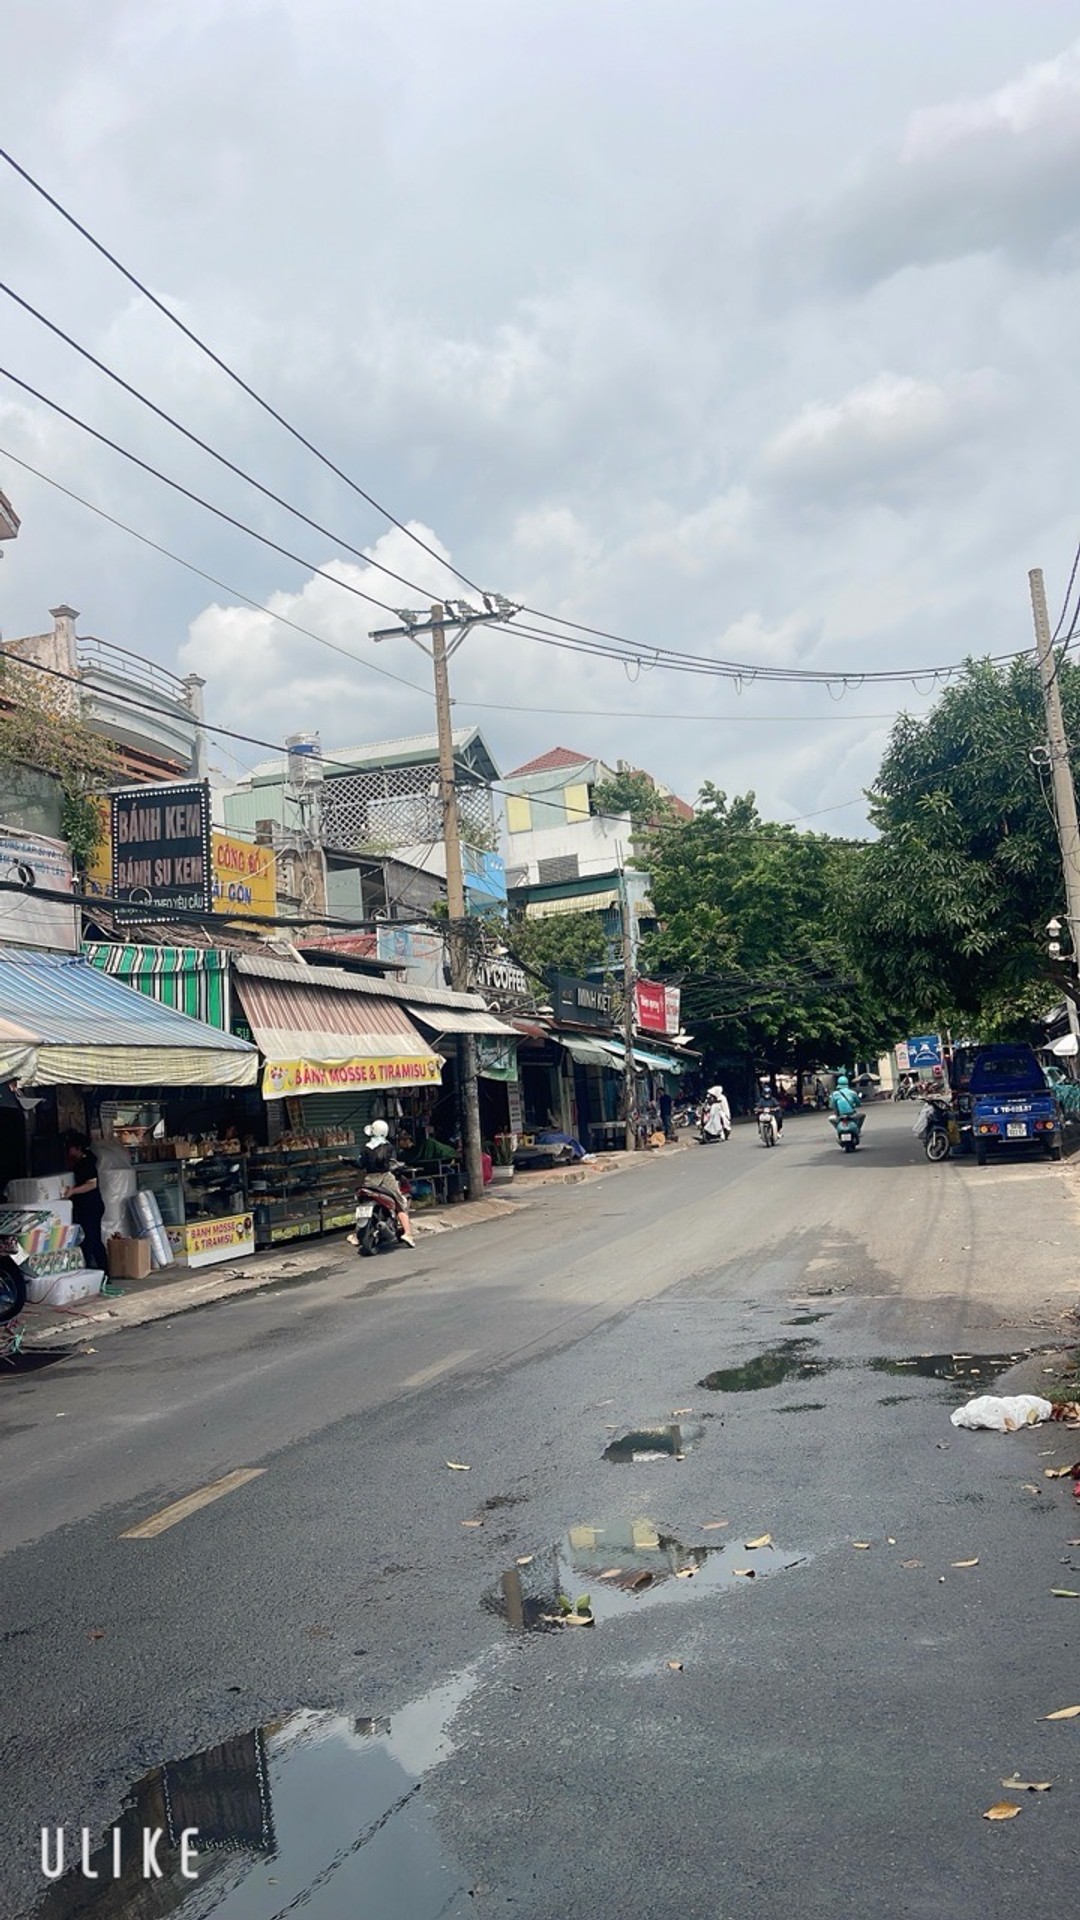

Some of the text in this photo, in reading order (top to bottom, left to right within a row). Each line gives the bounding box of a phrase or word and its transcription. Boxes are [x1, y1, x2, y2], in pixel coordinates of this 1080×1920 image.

[119, 802, 160, 843] BÁNH
[165, 804, 200, 839] KEM
[118, 856, 151, 889] BÁNH
[154, 859, 171, 886] SU
[175, 856, 203, 885] KEM
[329, 1066, 367, 1083] MOSSE
[369, 1066, 376, 1080] &
[378, 1064, 426, 1080] TIRAMISU
